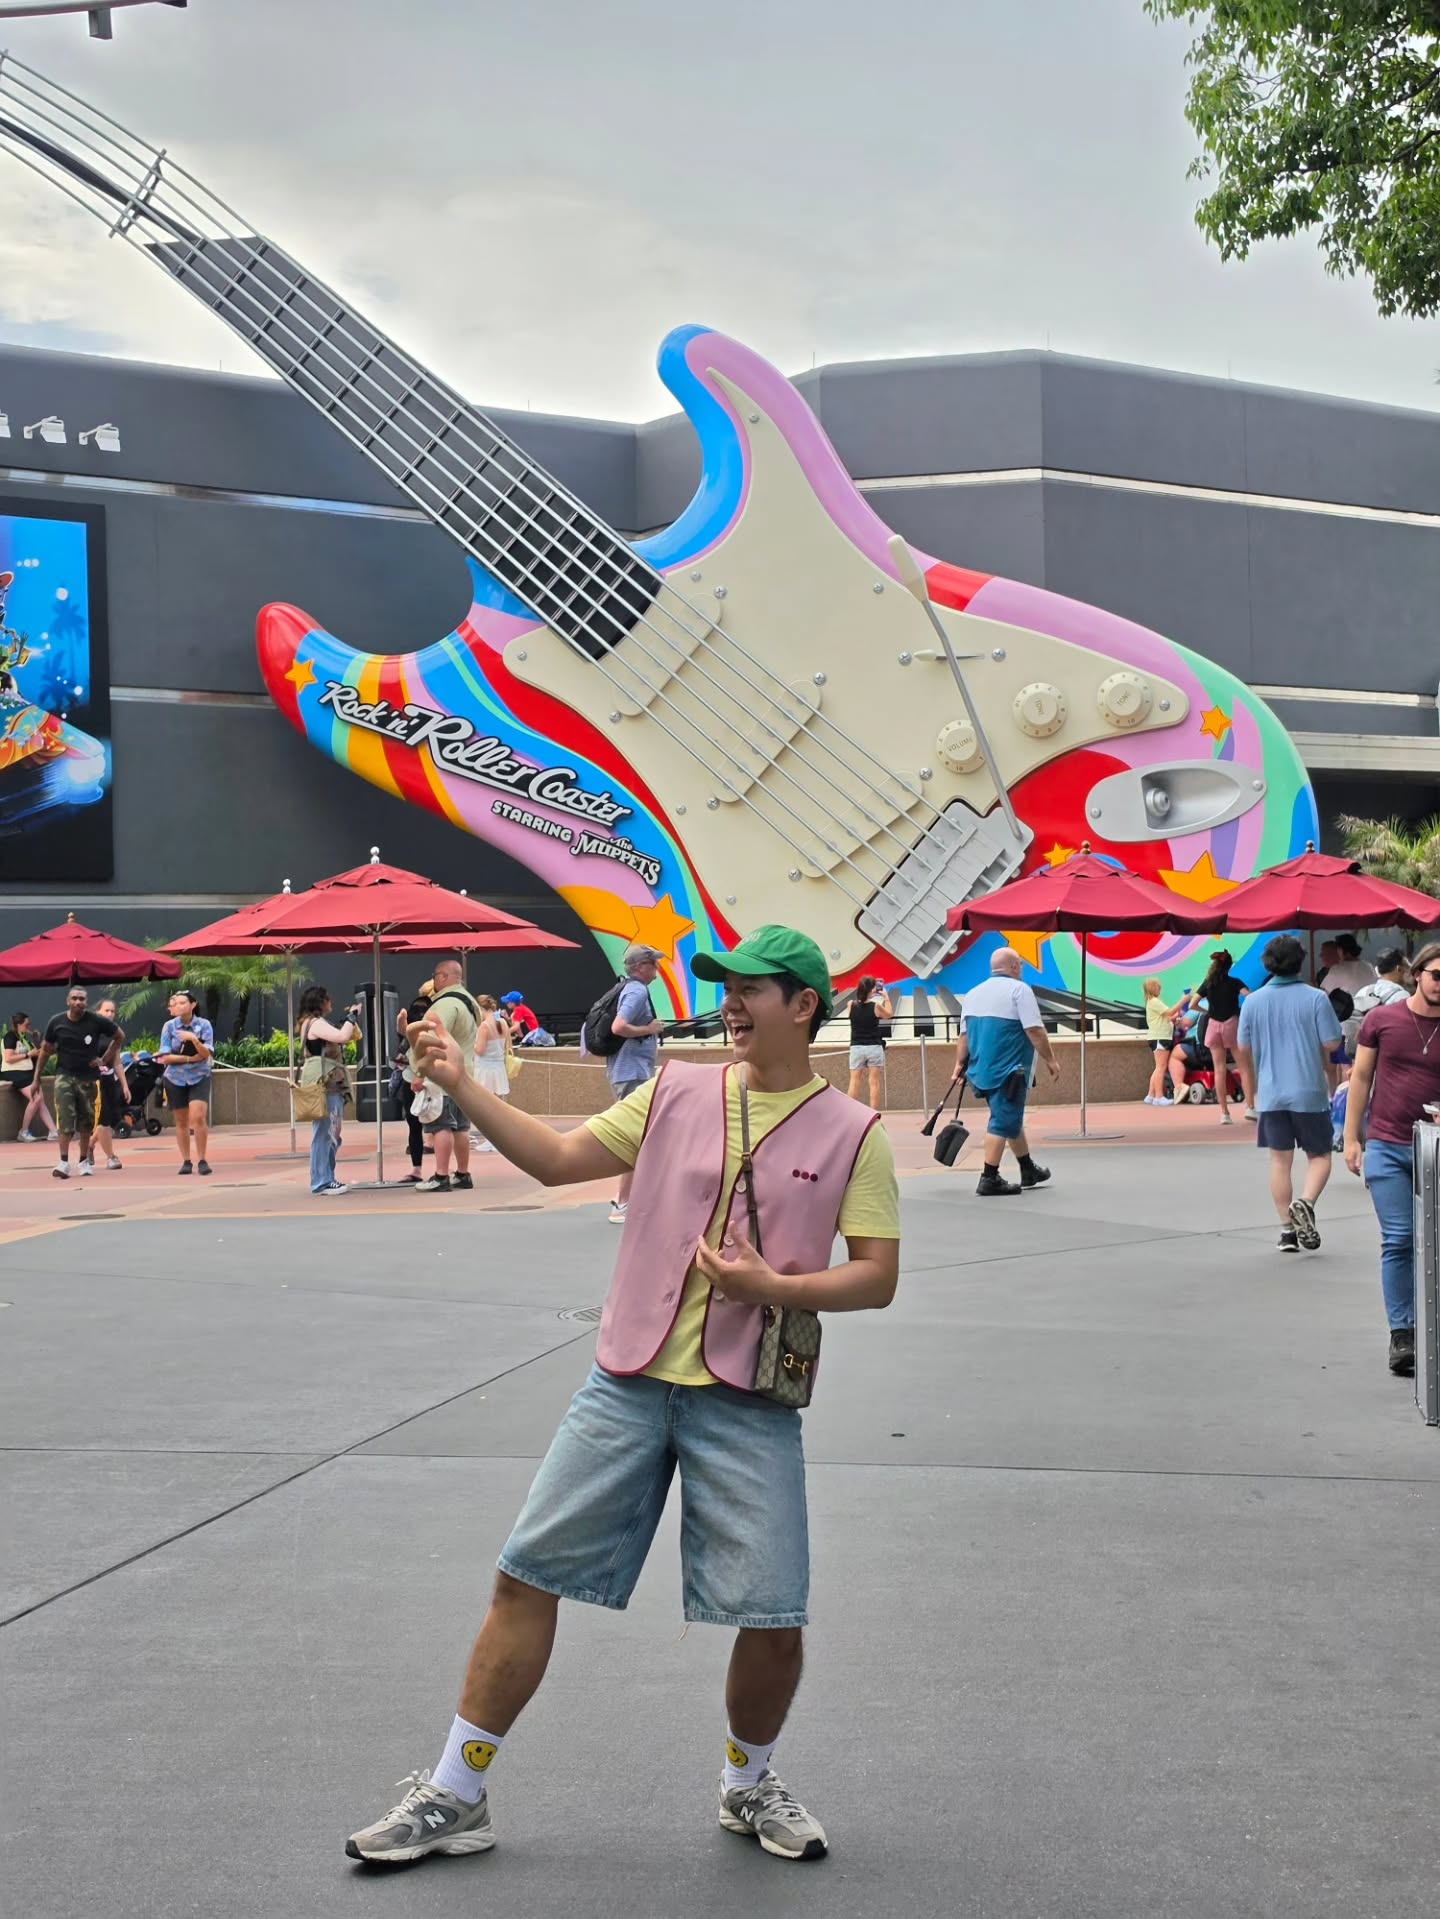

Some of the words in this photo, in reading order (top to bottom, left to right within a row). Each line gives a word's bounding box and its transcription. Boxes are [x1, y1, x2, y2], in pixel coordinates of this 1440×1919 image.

[318, 680, 396, 736] Rock
[403, 703, 534, 796] Roller
[528, 766, 632, 826] Coaster
[947, 736, 973, 752] VOLUME
[491, 800, 573, 844] STARRING
[609, 837, 634, 851] The
[569, 833, 662, 886] MUPPETS
[423, 1809, 447, 1829] N
[740, 1805, 755, 1822] N
